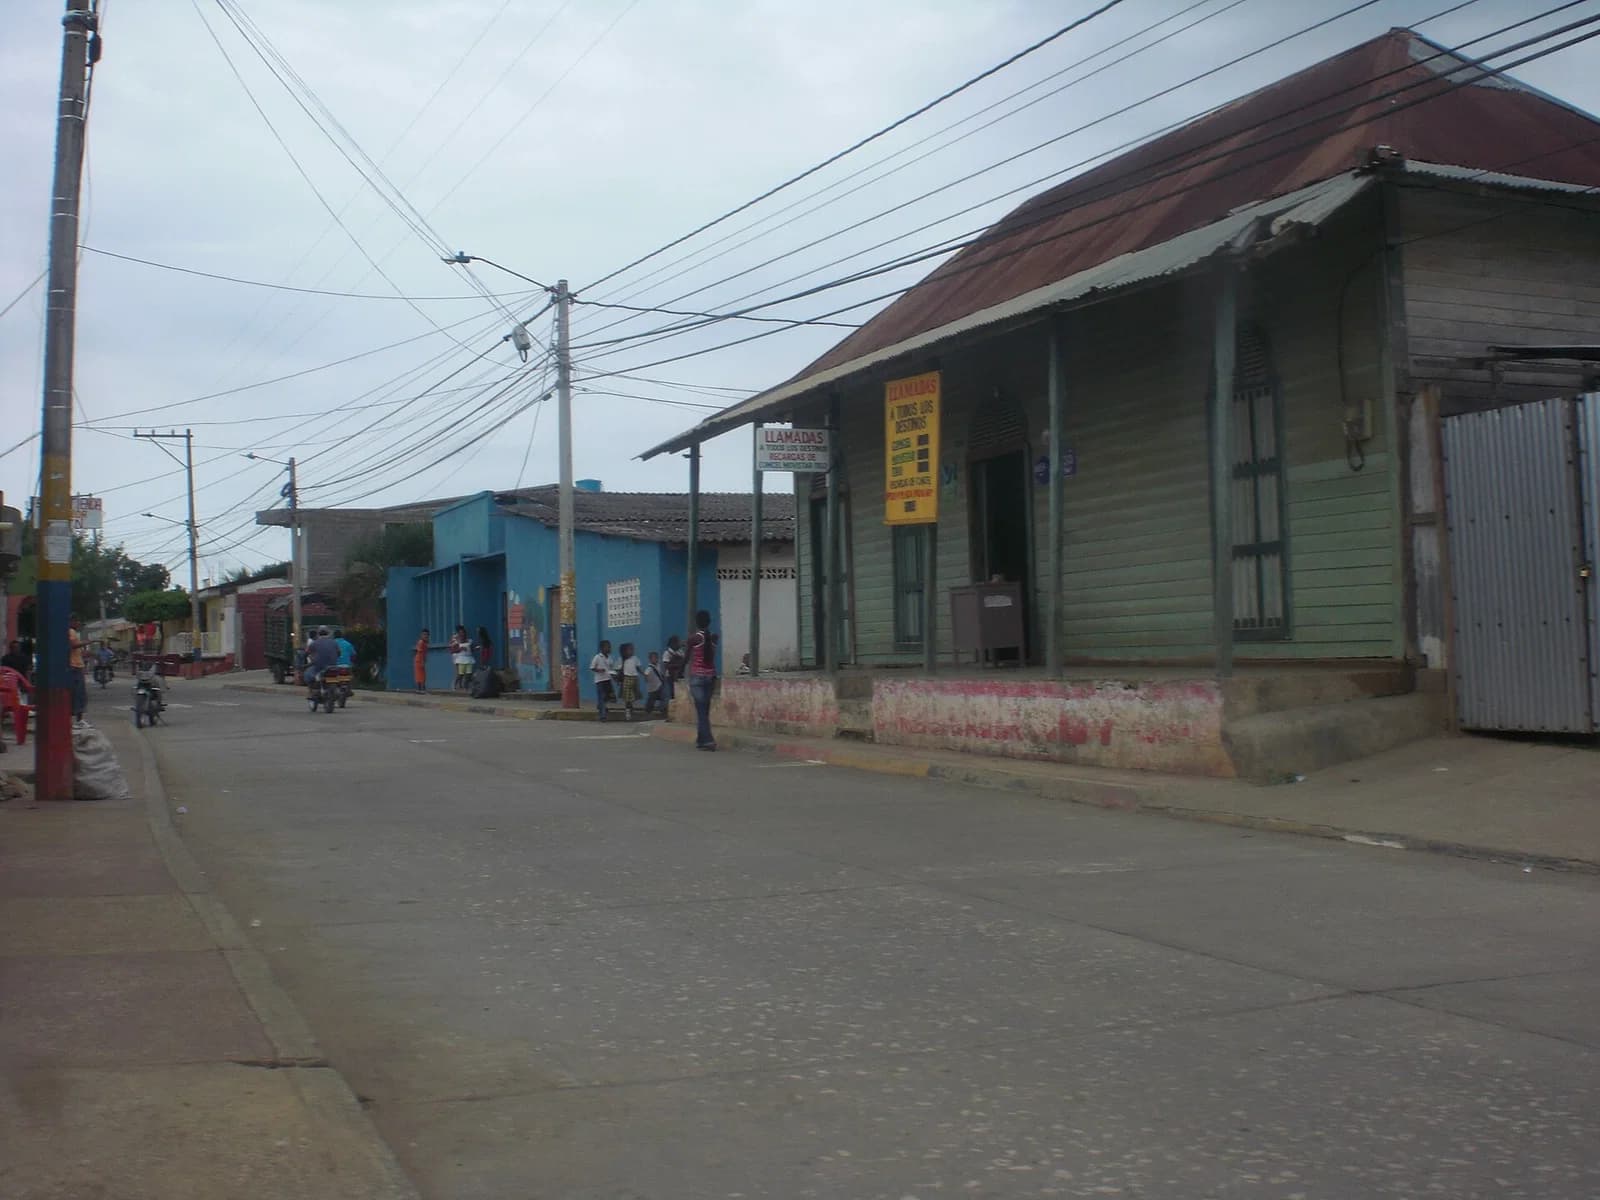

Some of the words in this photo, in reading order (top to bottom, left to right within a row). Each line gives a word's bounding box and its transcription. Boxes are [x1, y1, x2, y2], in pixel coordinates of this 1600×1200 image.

[888, 379, 936, 401] LLAMADAS
[764, 430, 824, 444] LLAMADAS
[769, 453, 804, 461] RECARGAS
